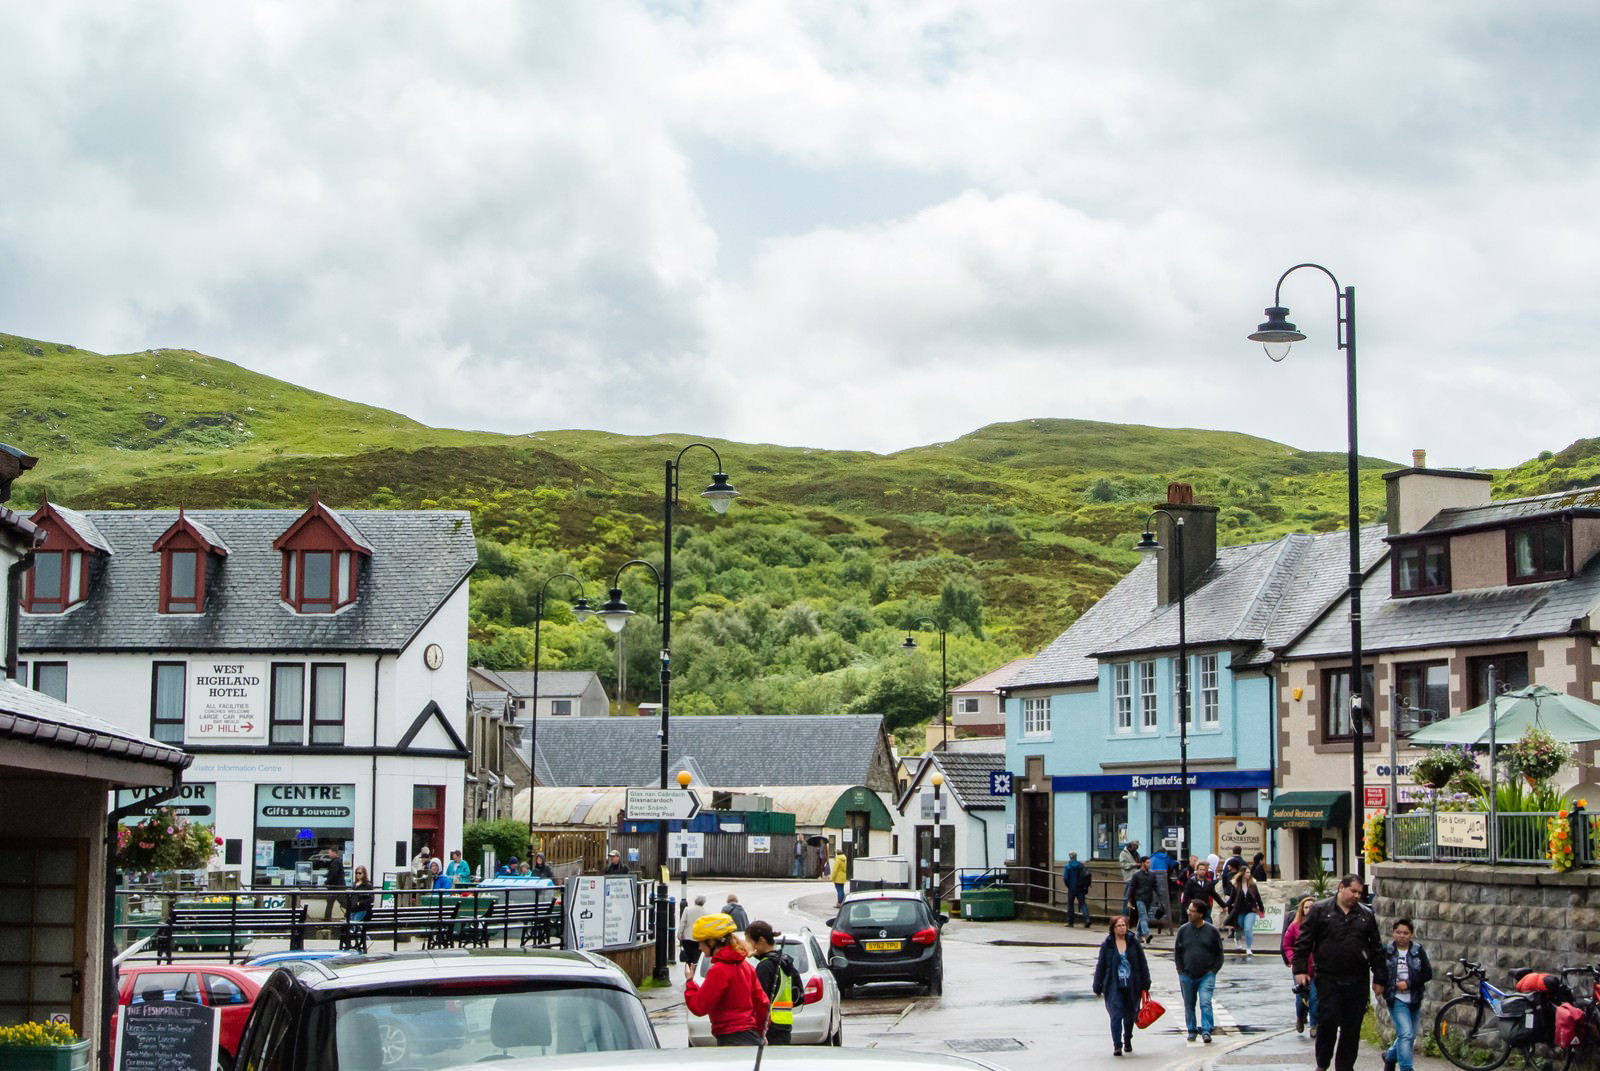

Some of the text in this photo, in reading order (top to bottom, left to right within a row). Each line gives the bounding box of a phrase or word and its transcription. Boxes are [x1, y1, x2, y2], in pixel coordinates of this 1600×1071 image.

[213, 665, 245, 674] WEST
[196, 676, 260, 686] HIGHLAND
[209, 688, 248, 697] HOTEL
[200, 724, 239, 733] UP HILL
[194, 764, 215, 772] Visitor
[258, 765, 282, 773] Centre
[1139, 776, 1154, 788] Royal
[1154, 776, 1167, 785] Bank
[1167, 775, 1173, 785] of
[271, 786, 342, 800] CENTRE
[266, 807, 347, 816] Gifts & Souvenirs
[1273, 808, 1324, 818] Seafood Restaurant
